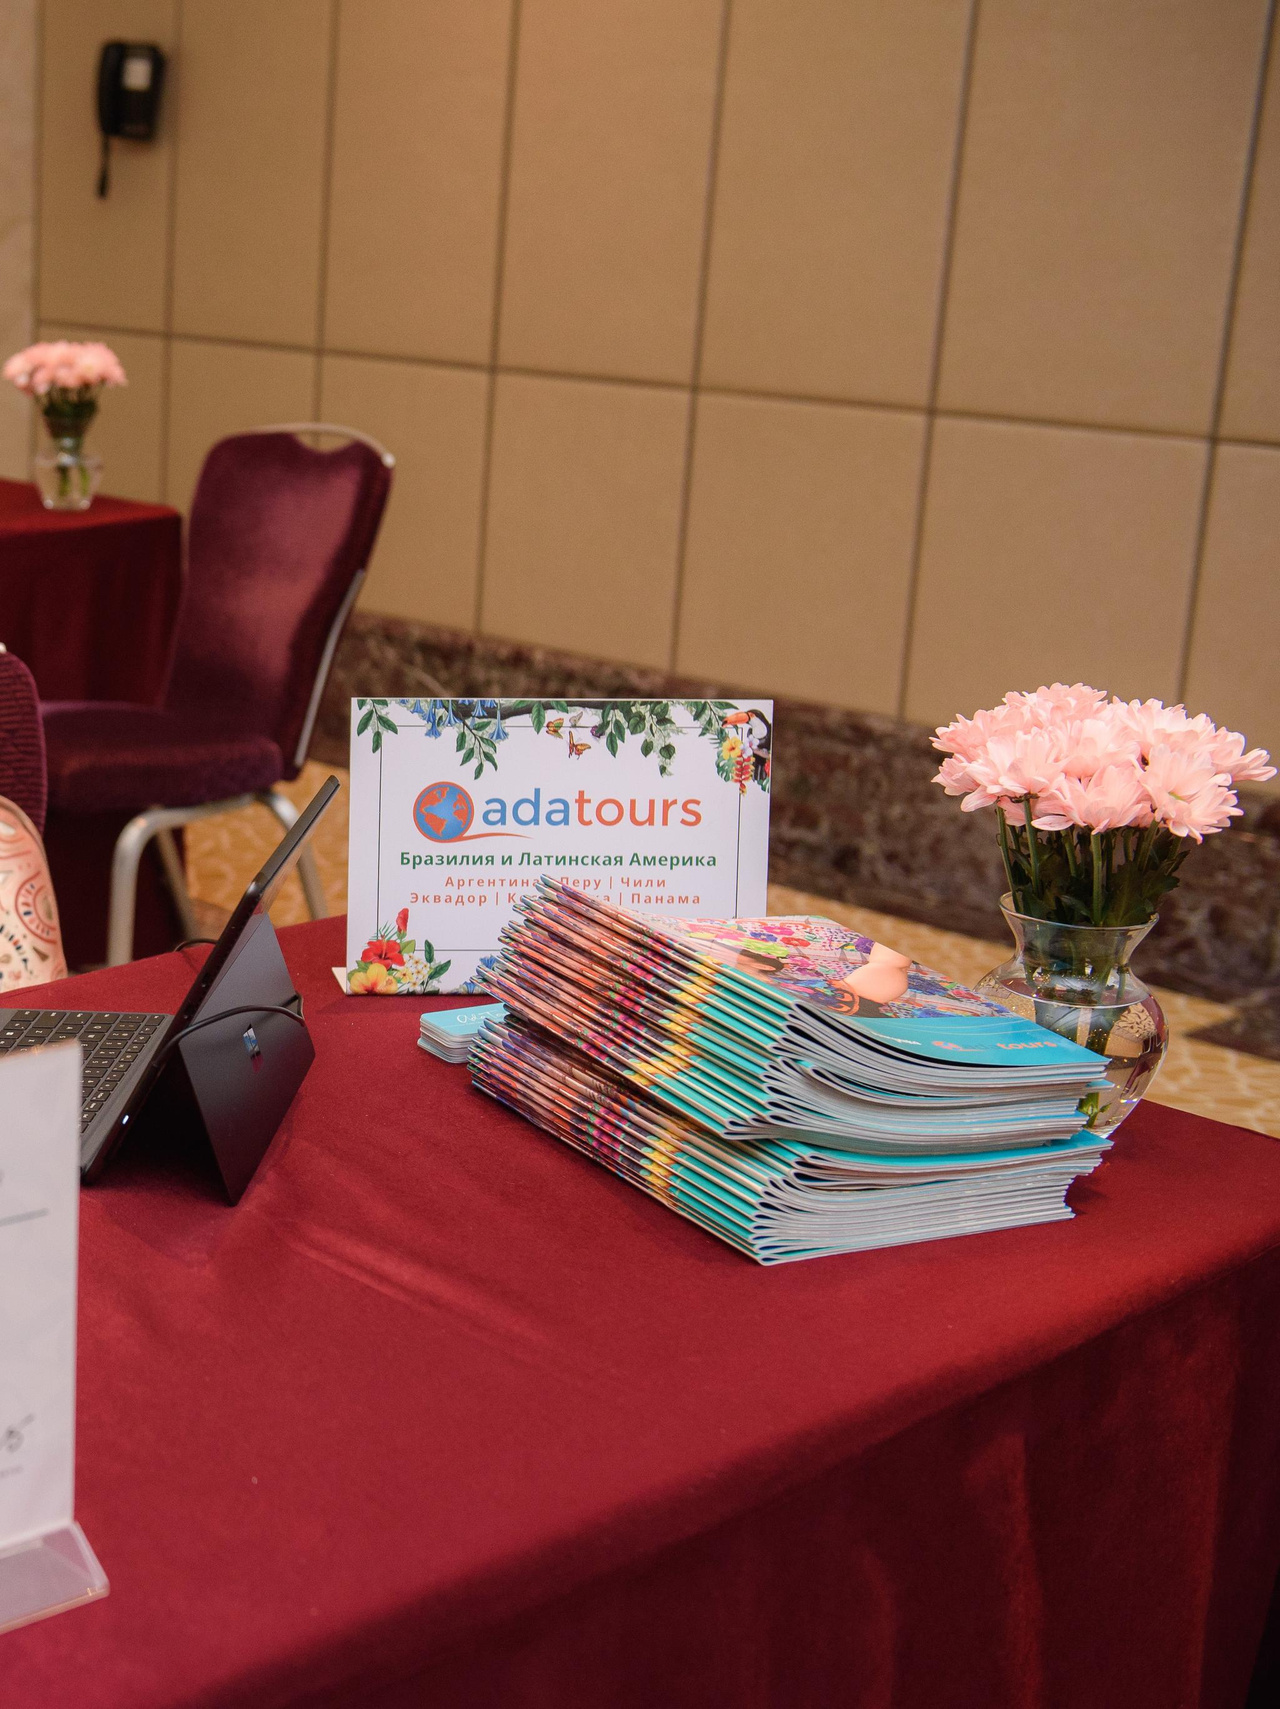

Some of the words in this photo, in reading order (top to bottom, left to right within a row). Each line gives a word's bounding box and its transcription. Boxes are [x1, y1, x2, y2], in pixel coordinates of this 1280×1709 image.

[481, 787, 703, 827] adatours
[400, 851, 495, 870] Бразилия
[501, 854, 513, 866] и
[518, 851, 624, 867] Латинская
[628, 852, 717, 871] Америка
[444, 876, 540, 890] Аргентина
[560, 876, 601, 890] Перу
[620, 876, 667, 888] Чили
[409, 892, 488, 907] Эквадор
[631, 892, 701, 905] Панама
